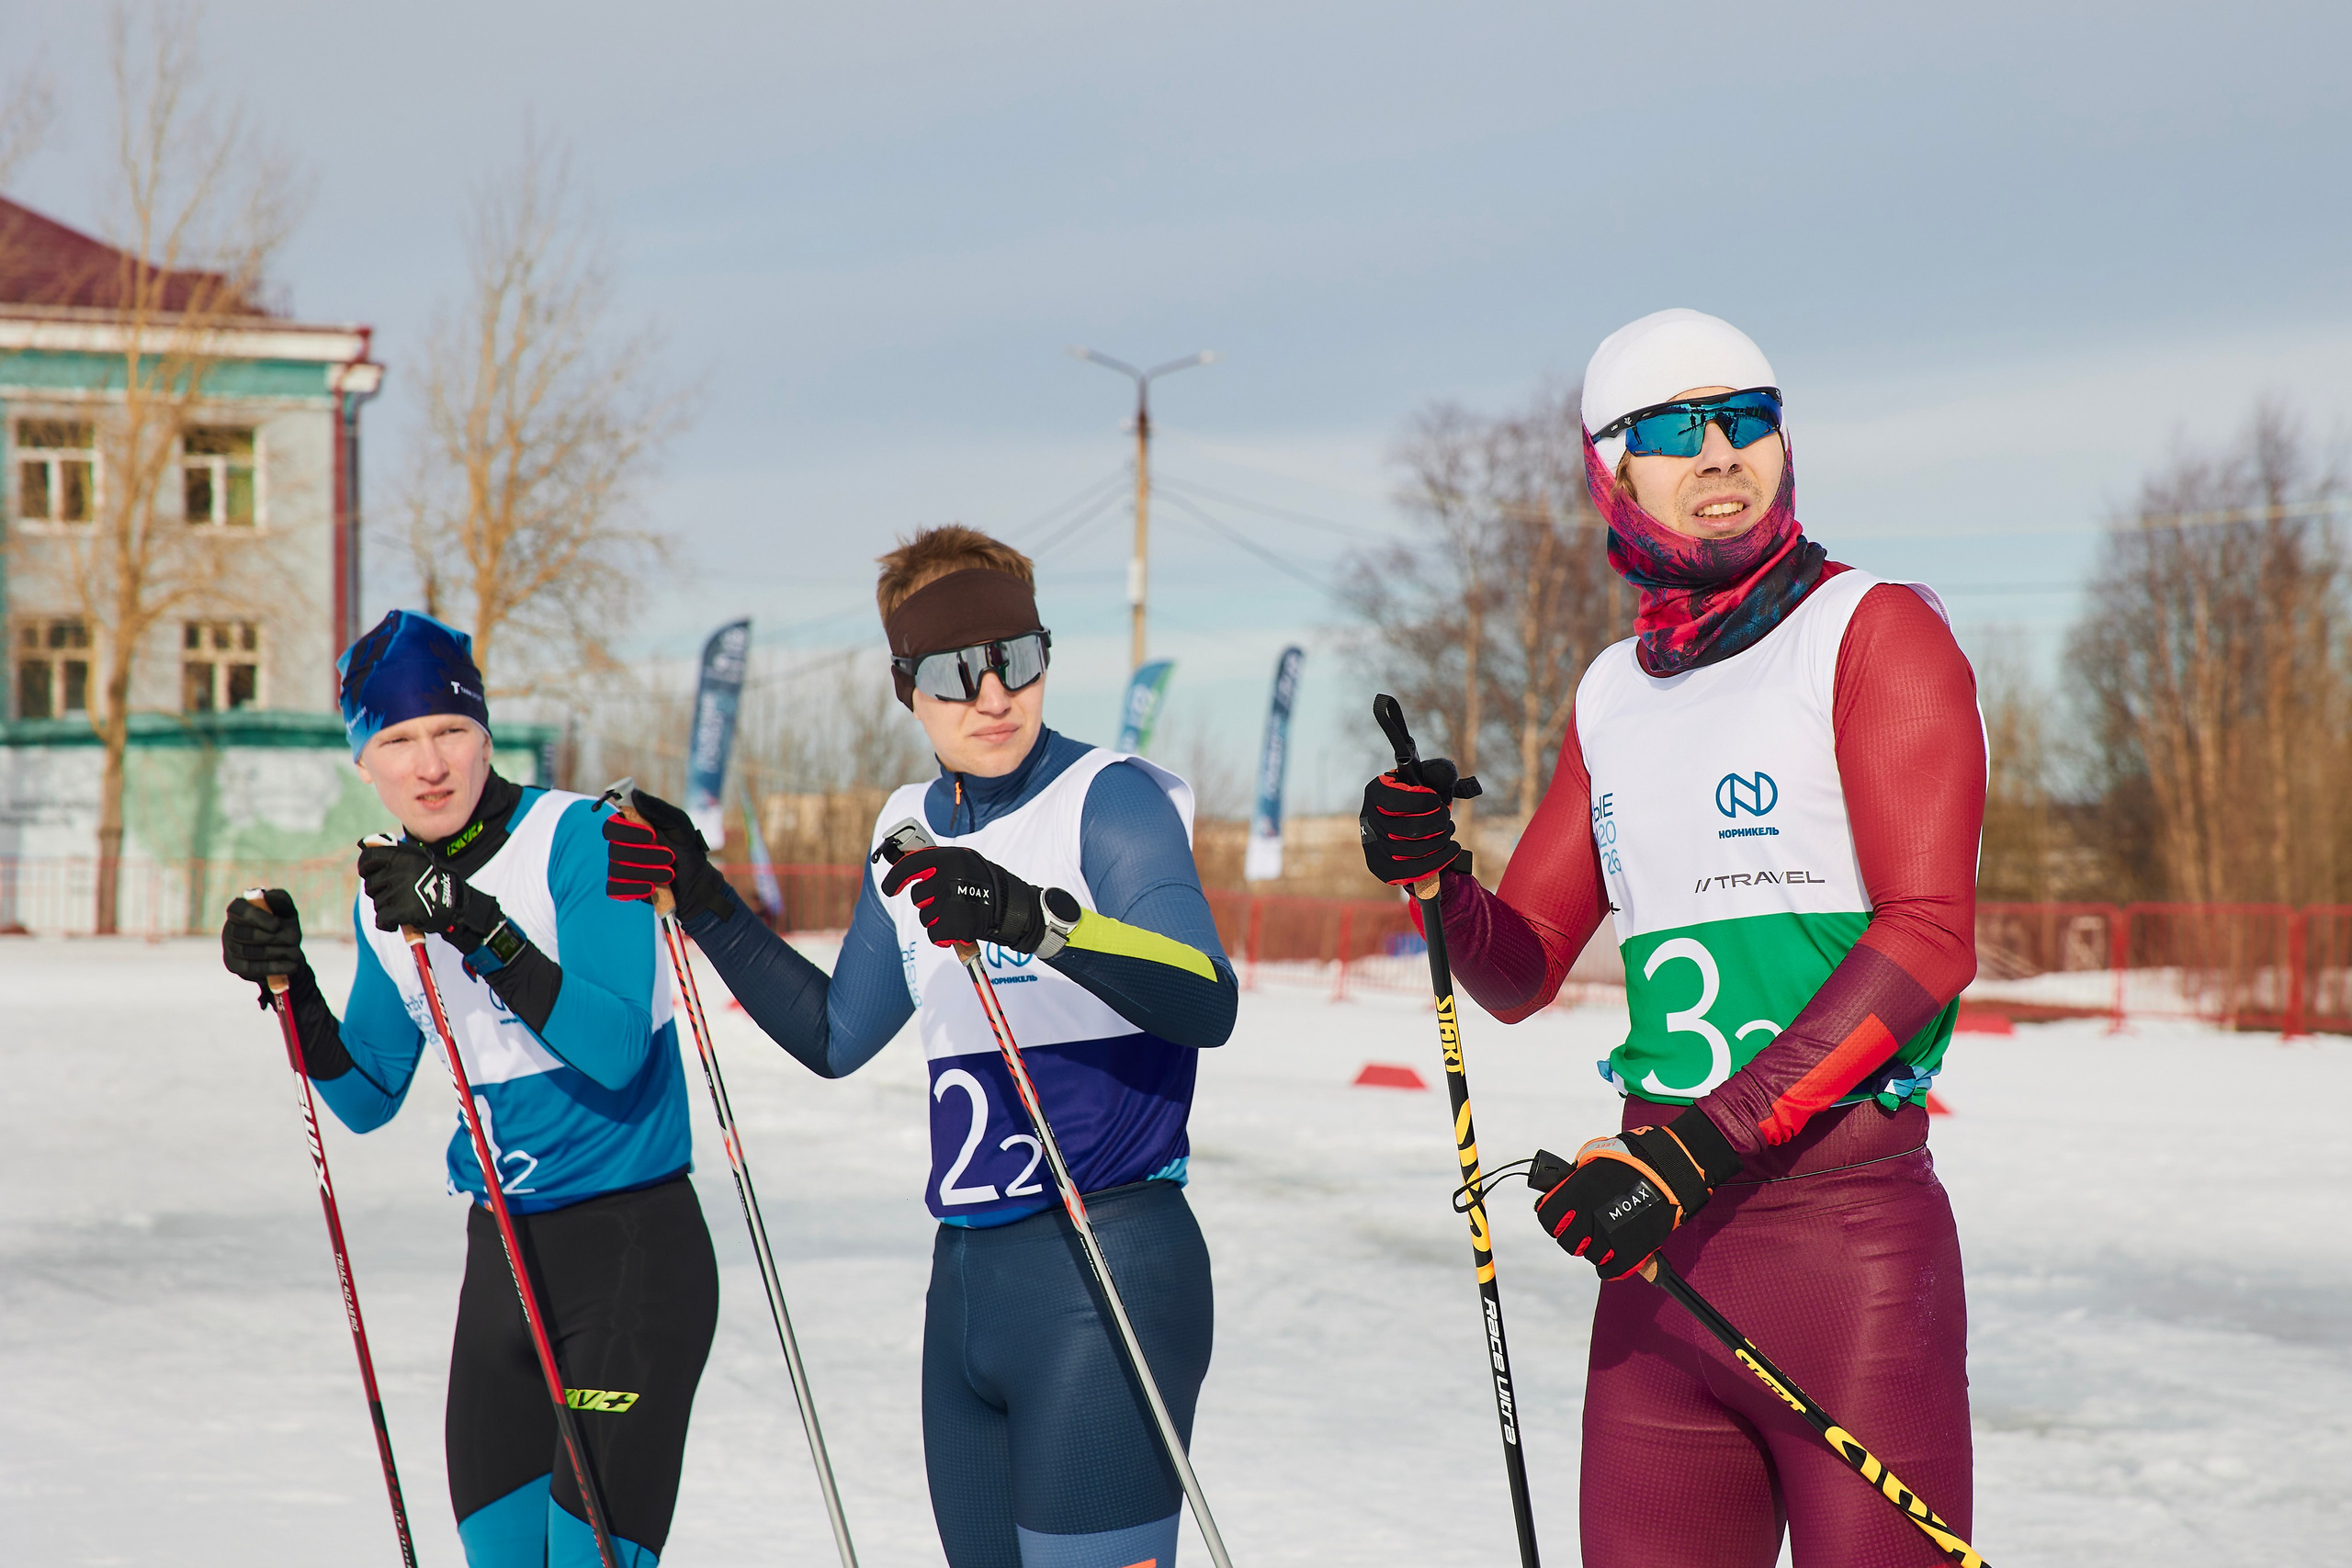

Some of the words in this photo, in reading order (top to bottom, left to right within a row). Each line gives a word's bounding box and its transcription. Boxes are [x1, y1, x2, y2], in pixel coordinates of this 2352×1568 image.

[1718, 827, 1780, 840] НОРНИКЕЛЬ
[1602, 848, 1622, 875] 26
[956, 885, 989, 898] MOAX
[1433, 994, 1464, 1077] START
[1609, 1188, 1650, 1221] MOAX
